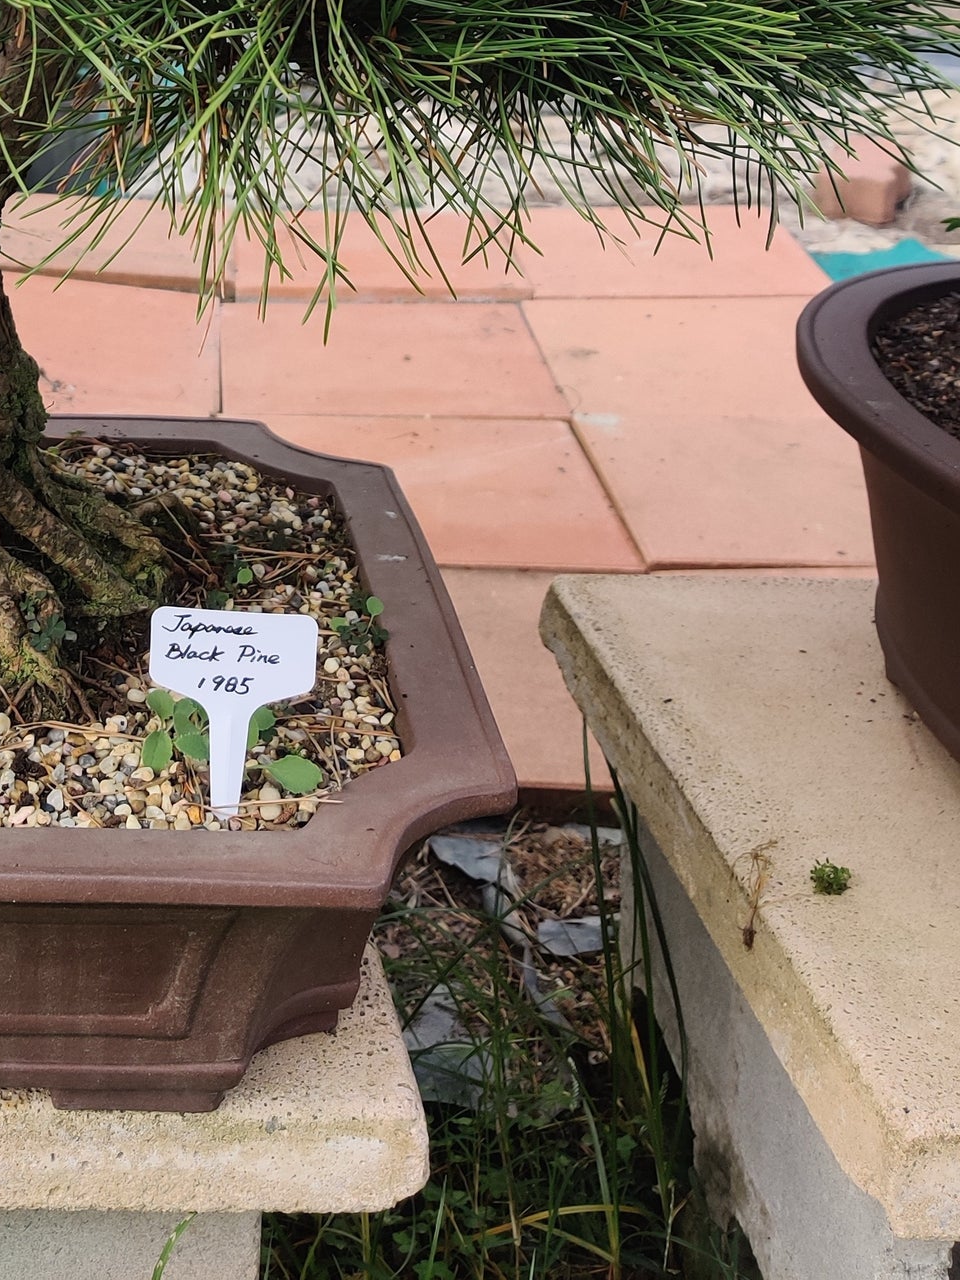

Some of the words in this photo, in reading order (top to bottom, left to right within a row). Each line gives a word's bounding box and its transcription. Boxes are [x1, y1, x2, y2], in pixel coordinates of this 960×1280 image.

[162, 614, 258, 639] Japanese
[165, 643, 225, 662] Black
[237, 645, 281, 665] Pine
[198, 675, 254, 695] 1985
